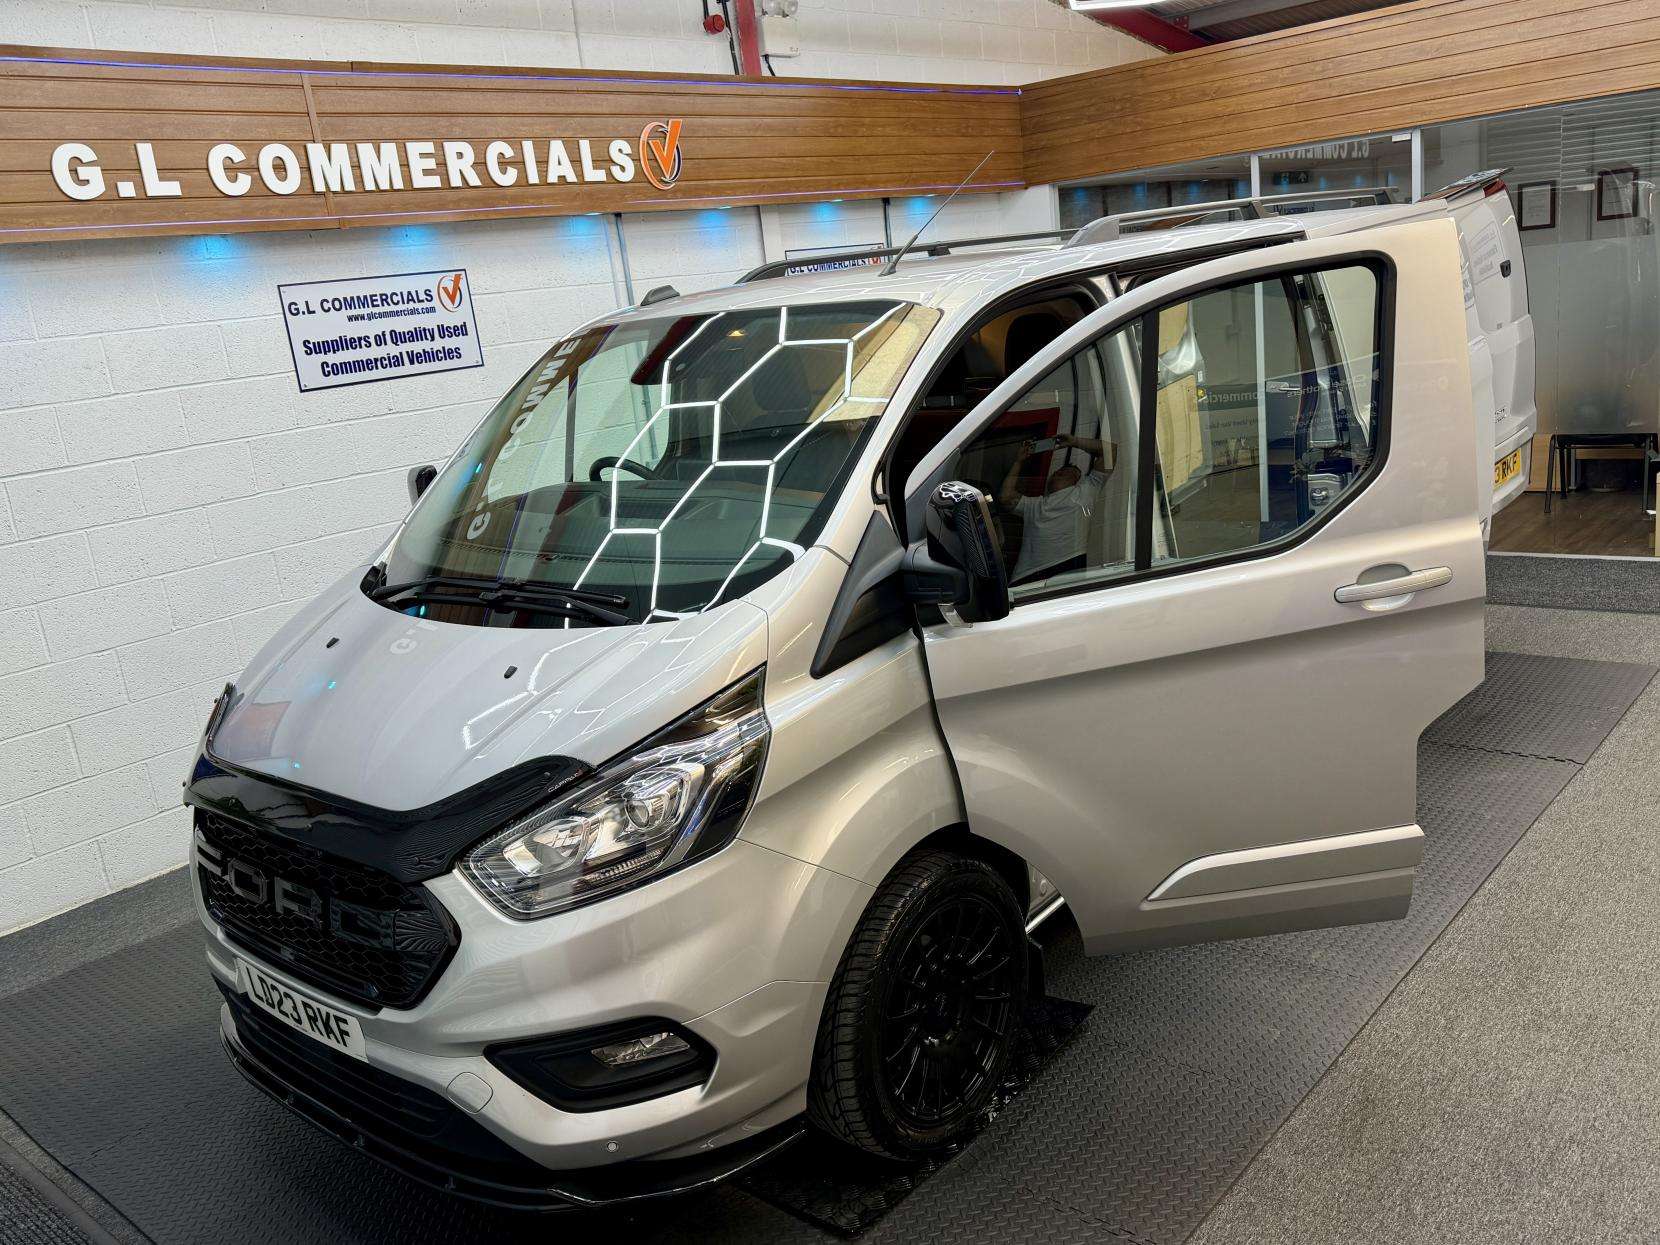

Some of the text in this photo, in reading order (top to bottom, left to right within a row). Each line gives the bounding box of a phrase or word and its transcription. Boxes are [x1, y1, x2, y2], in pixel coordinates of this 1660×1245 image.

[51, 139, 636, 201] G.L COMMERCIALS
[287, 288, 434, 317] G.L COMMERCIALS
[347, 305, 437, 323] www.glcommercials.com
[302, 321, 469, 356] Suppliers of Quality Used
[321, 345, 462, 378] Commercial Vehicles
[245, 965, 352, 1048] LD23 RKF
